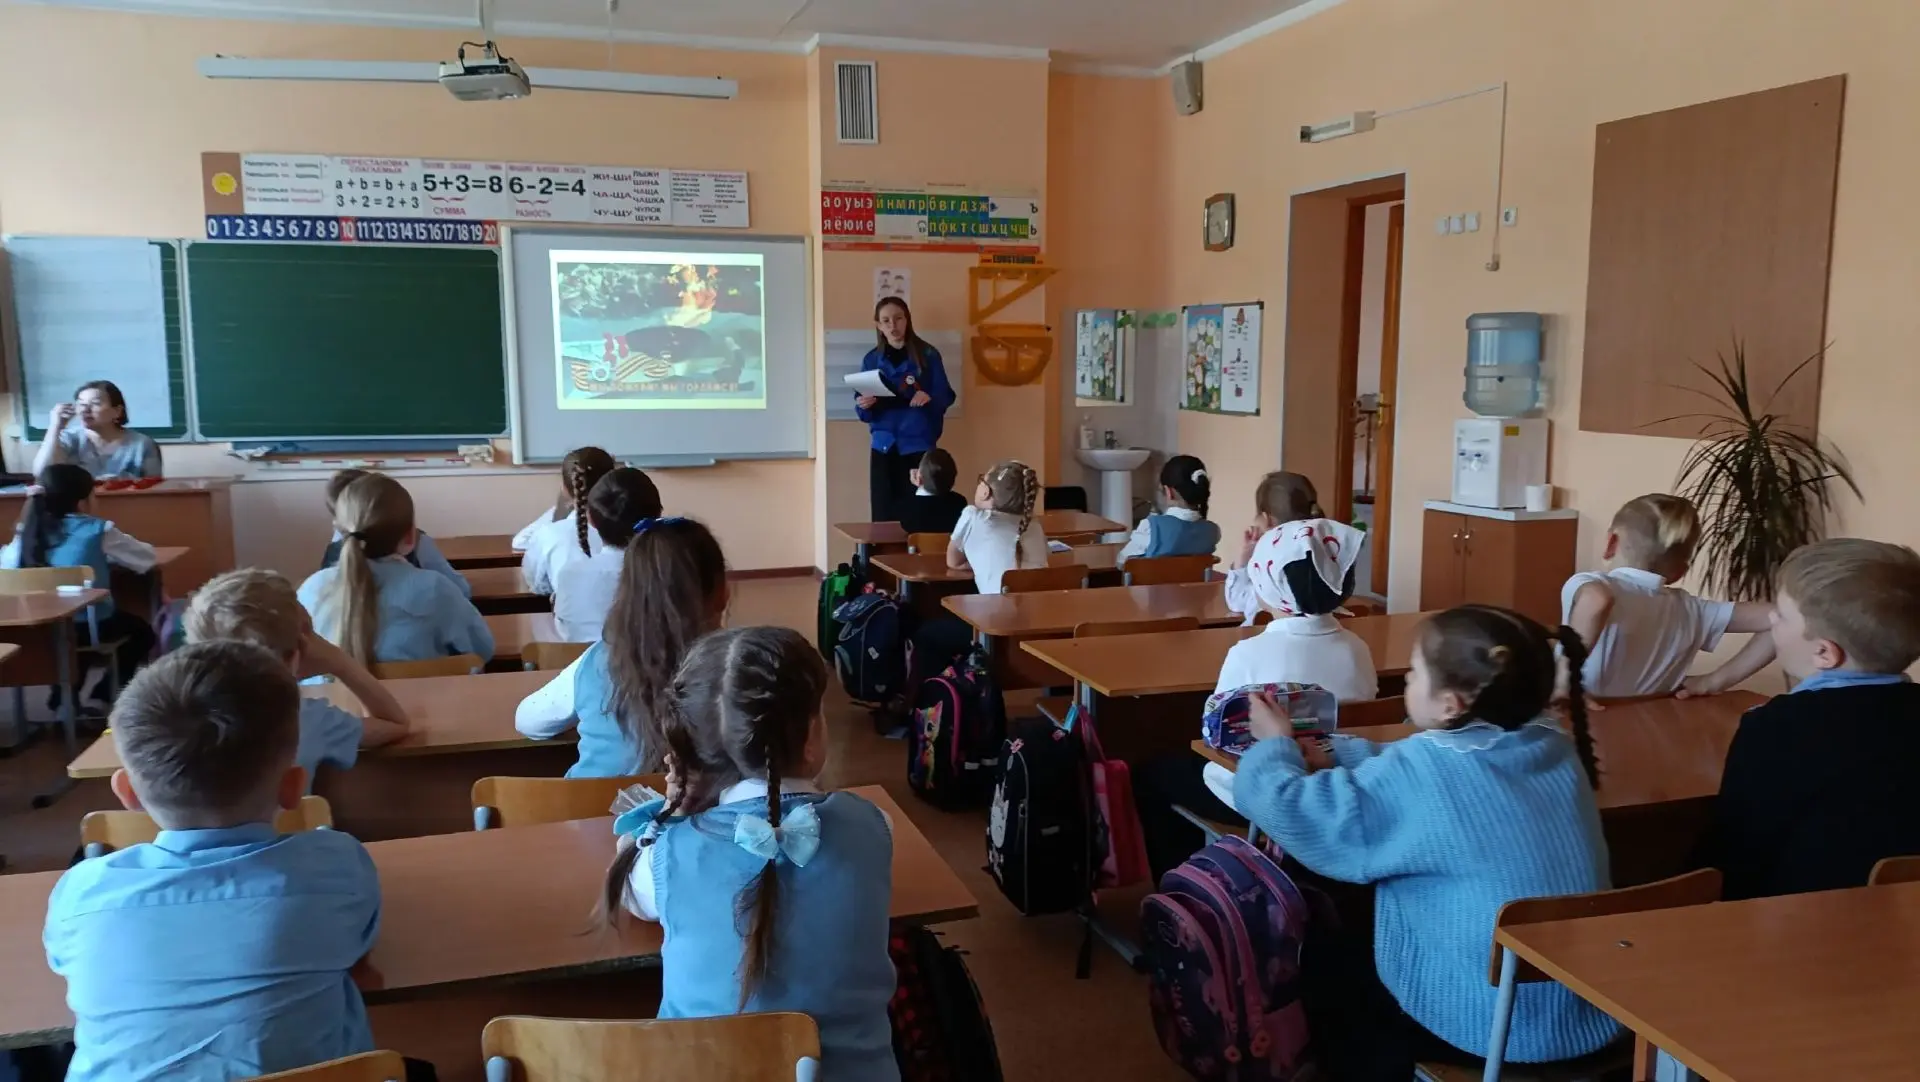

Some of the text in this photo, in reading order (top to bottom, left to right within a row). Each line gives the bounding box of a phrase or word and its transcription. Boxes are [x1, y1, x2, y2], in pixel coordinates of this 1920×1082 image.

[423, 174, 503, 193] 5+3=8
[433, 206, 466, 216] СУММА
[208, 218, 496, 242] 0 1 2 3 4 5 6 7 8 9 10 11 12 13 14 15 16 17 18 19 20
